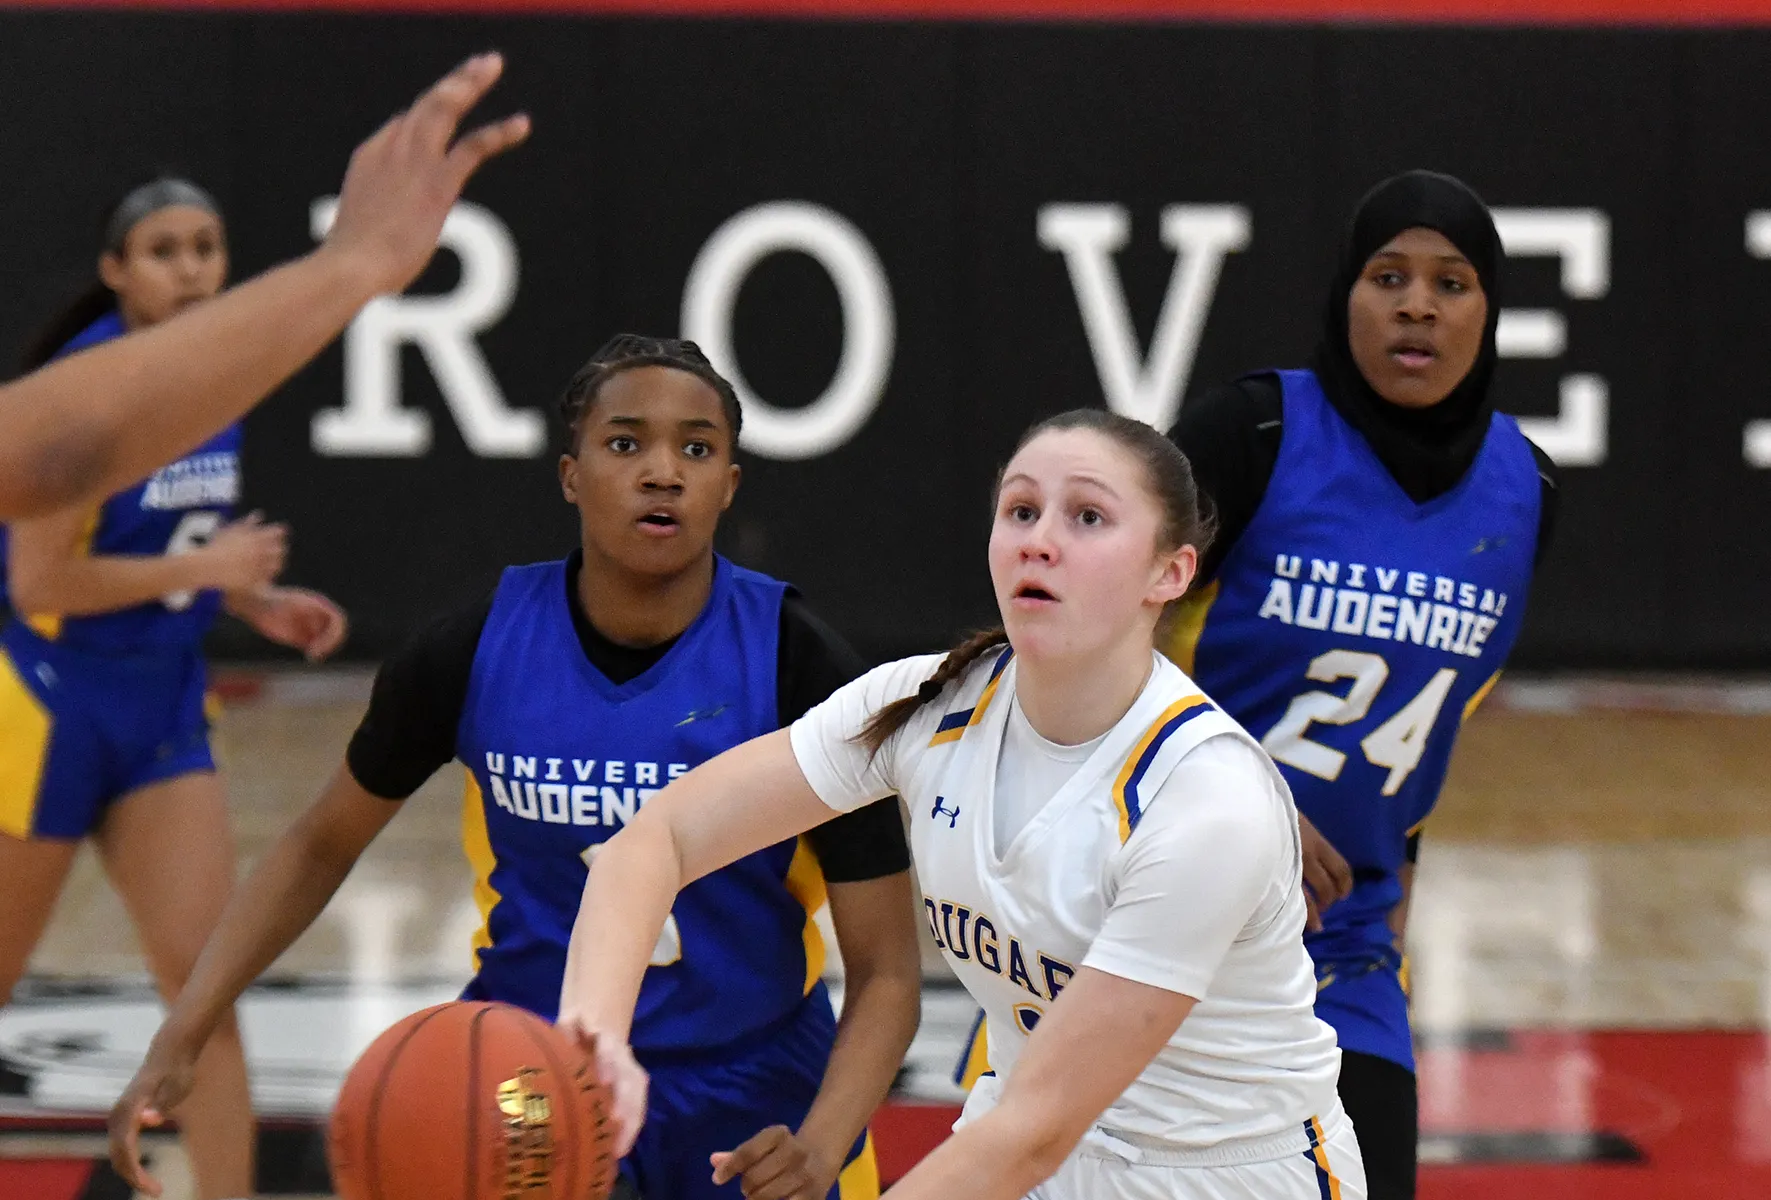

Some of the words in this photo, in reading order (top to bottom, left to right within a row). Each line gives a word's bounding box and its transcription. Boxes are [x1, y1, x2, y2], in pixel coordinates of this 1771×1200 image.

[311, 198, 1771, 468] ROVE
[1257, 578, 1498, 658] AUDENRIE
[485, 750, 690, 786] UNIVERS
[1260, 649, 1459, 797] 24
[489, 774, 664, 826] AUDEN
[923, 896, 1077, 1002] OUGAR
